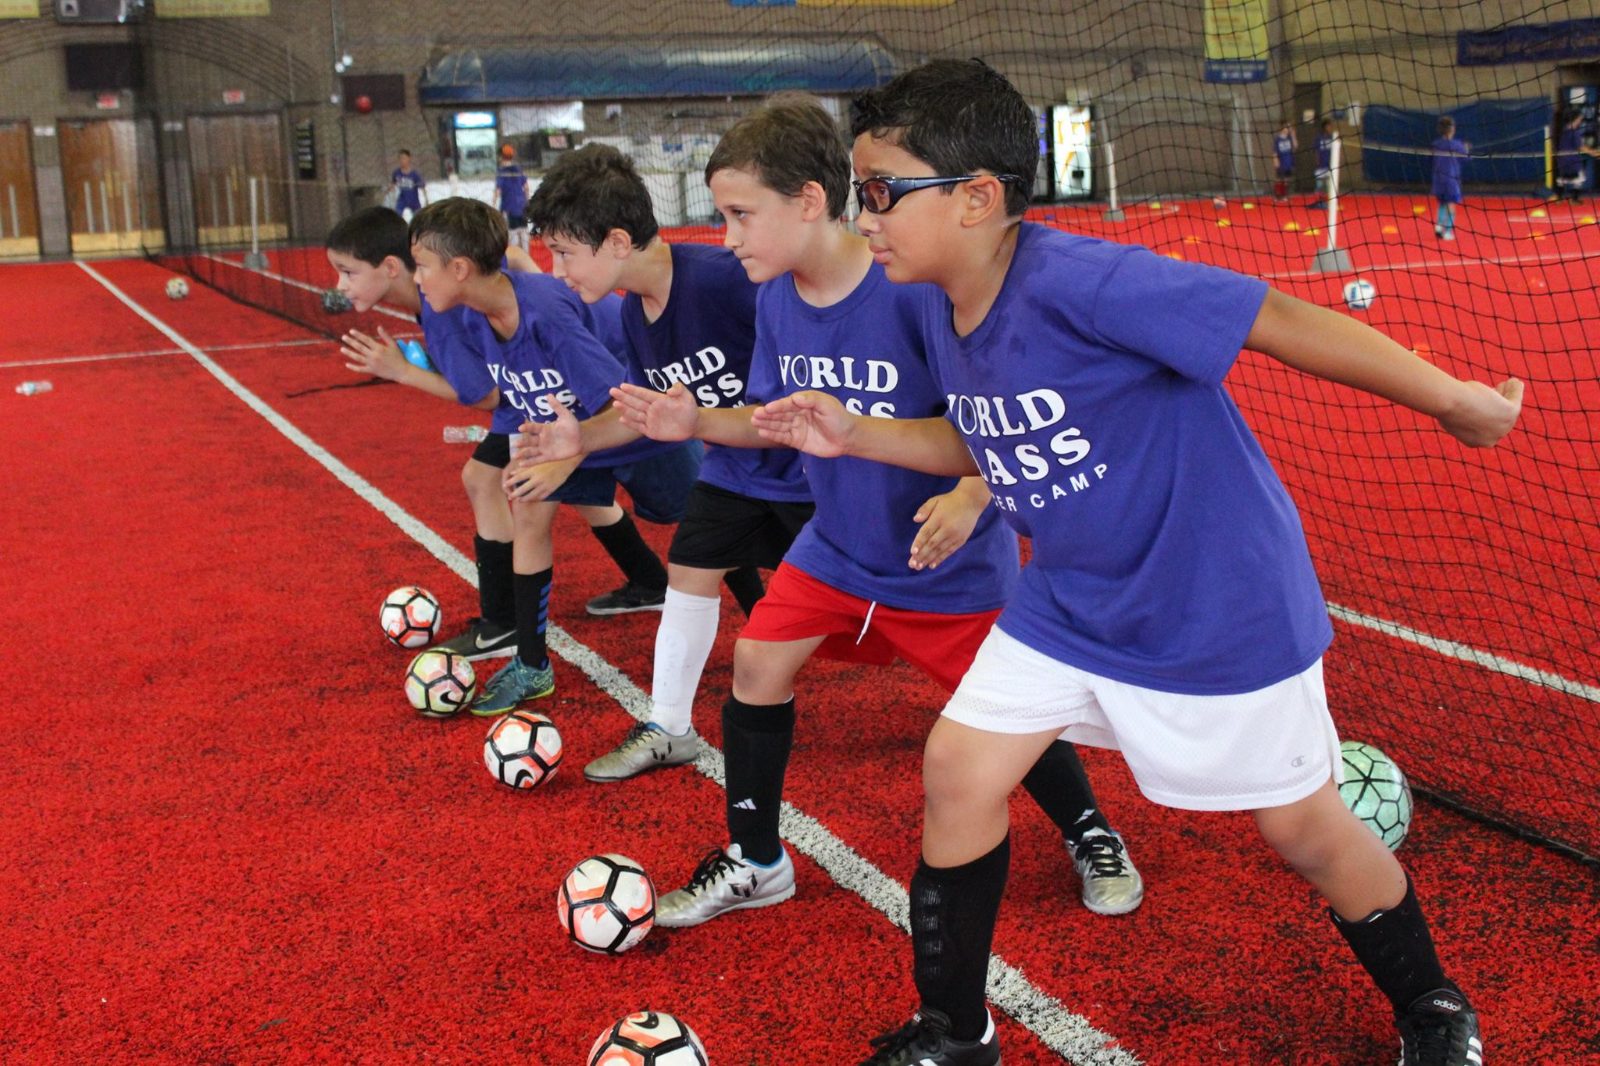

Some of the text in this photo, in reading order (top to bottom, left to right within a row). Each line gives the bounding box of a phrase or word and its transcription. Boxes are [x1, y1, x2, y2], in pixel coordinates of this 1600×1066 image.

[947, 388, 1066, 438] ORLD
[966, 427, 1091, 486] ASS
[1029, 463, 1108, 508] CAMP
